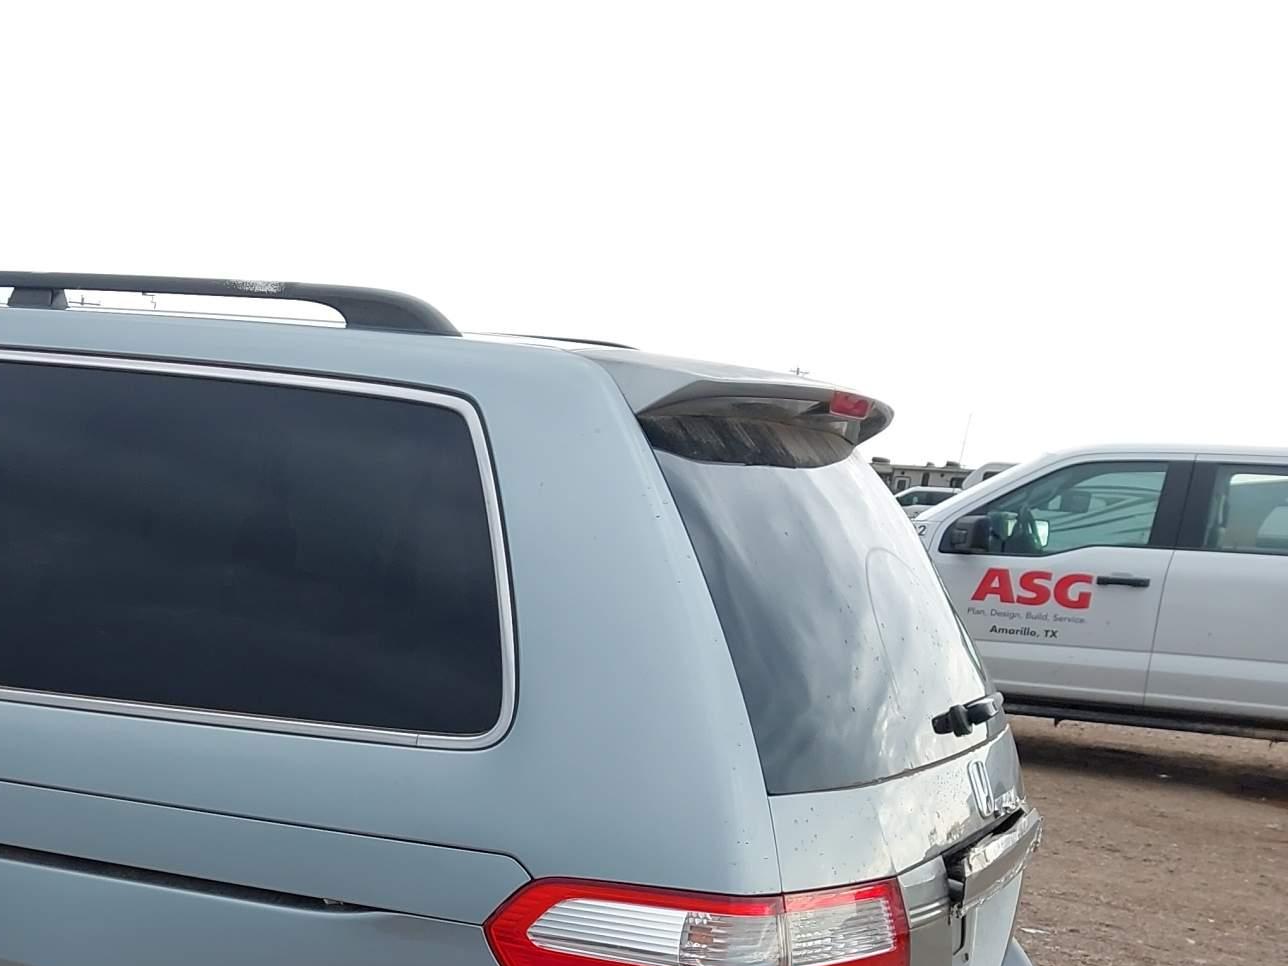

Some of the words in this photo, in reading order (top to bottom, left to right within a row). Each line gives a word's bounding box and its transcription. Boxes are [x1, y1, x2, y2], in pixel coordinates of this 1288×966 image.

[970, 567, 1093, 609] ASG
[989, 624, 1040, 637] Amarillo,
[1044, 629, 1059, 639] TX
